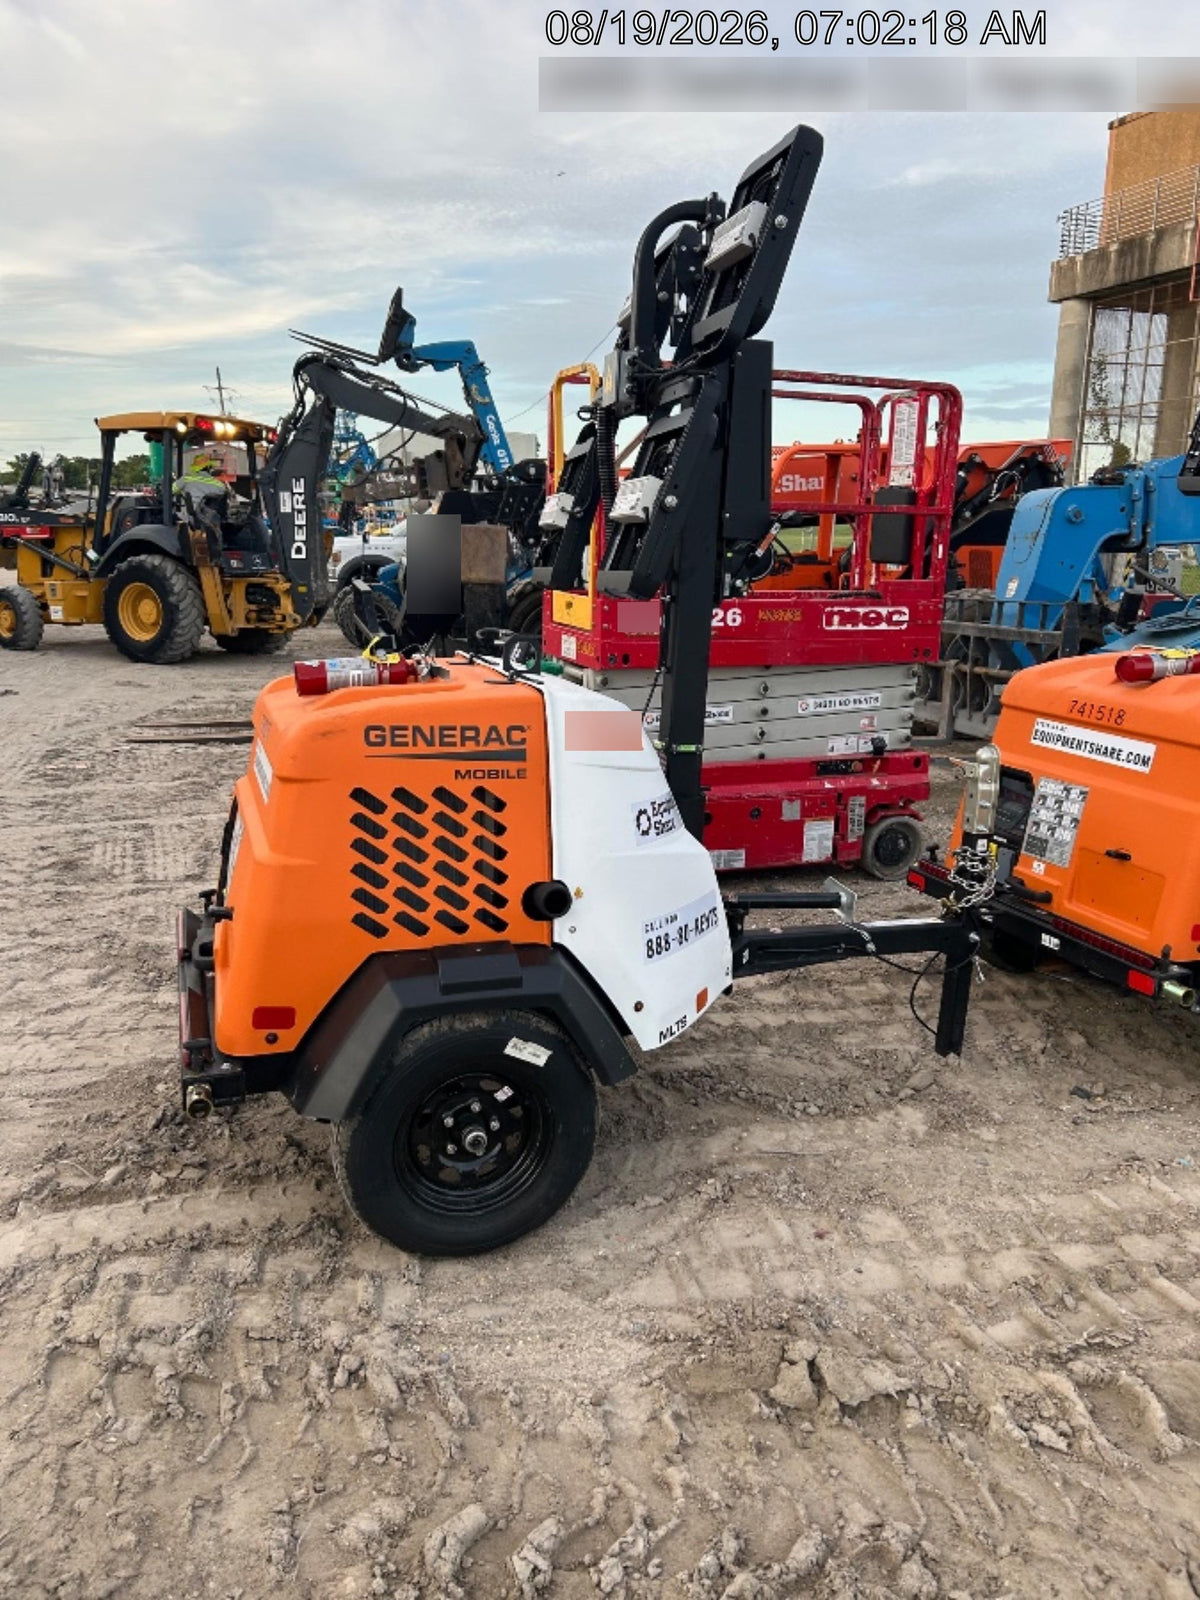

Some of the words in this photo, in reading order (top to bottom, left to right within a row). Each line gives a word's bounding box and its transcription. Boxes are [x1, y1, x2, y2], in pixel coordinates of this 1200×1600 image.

[290, 477, 307, 559] DEERE
[711, 607, 742, 627] 26
[1068, 700, 1127, 726] 741518
[364, 725, 528, 748] GENERAC
[1032, 728, 1152, 769] EQUIPMENTSHARE.COM
[454, 768, 527, 780] MOBILE
[659, 1014, 688, 1044] MLTS
